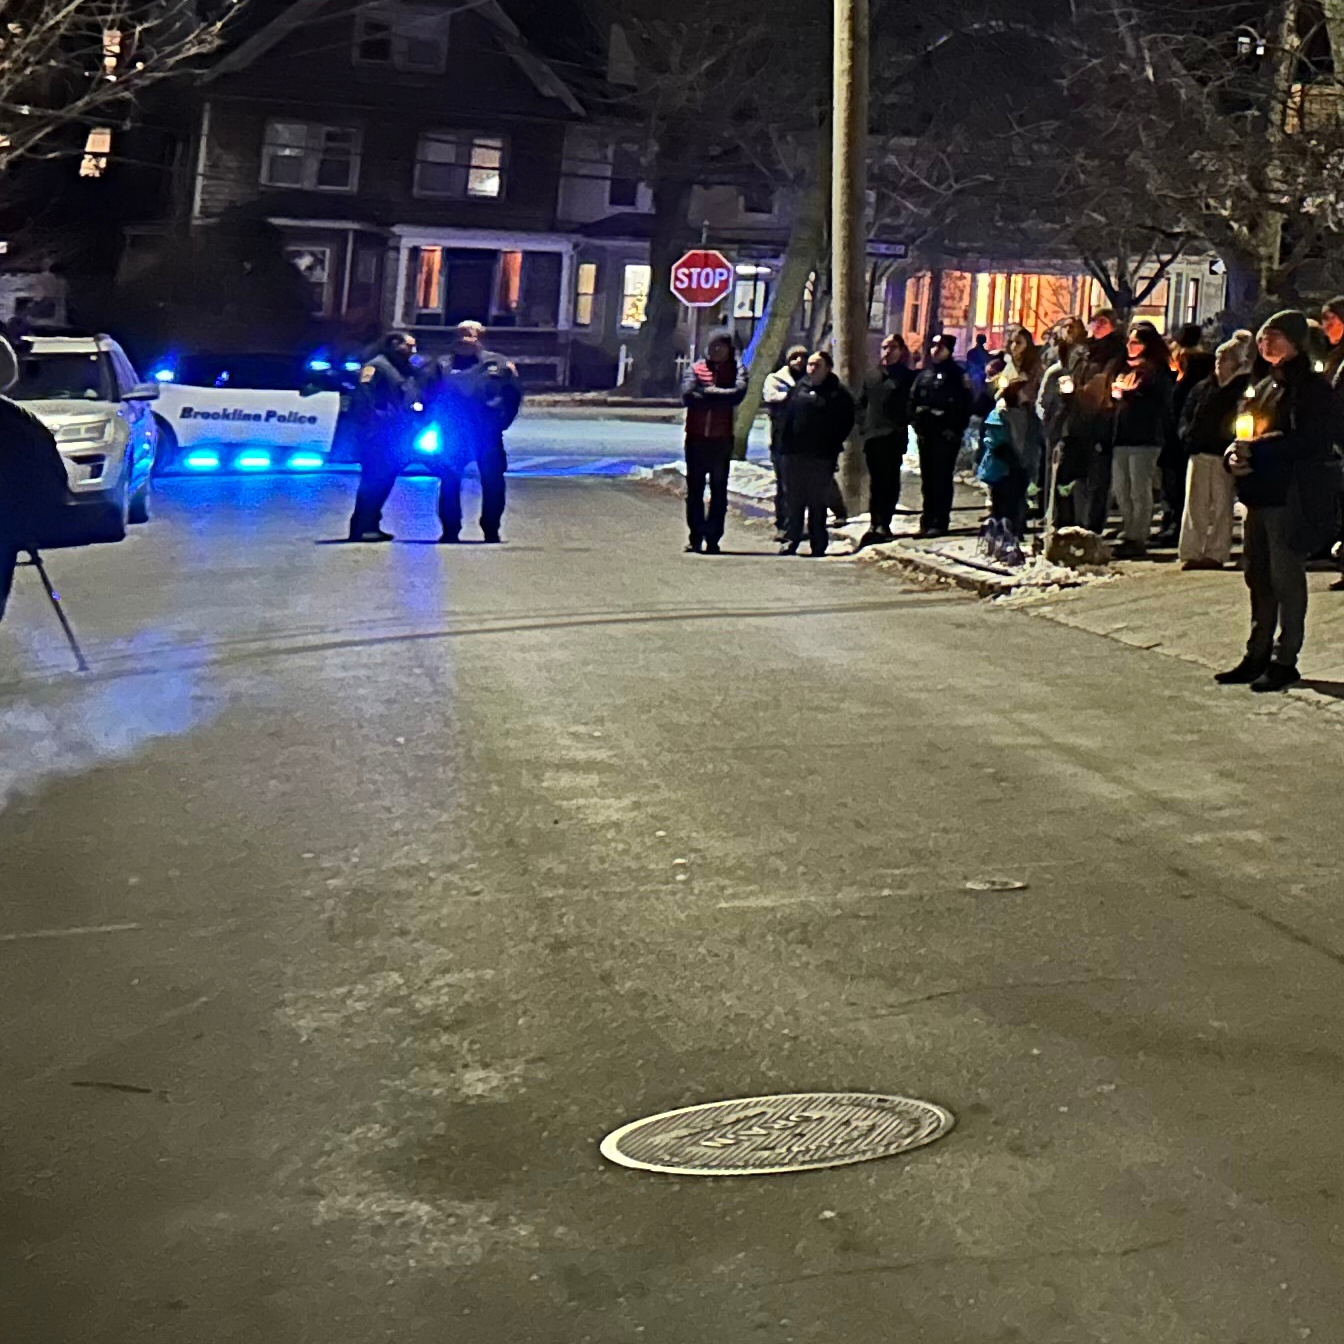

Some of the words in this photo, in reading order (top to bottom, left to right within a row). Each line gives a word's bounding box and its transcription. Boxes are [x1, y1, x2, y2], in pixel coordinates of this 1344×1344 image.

[675, 267, 728, 289] STOP
[180, 407, 262, 422] Brookline
[264, 410, 317, 425] Police
